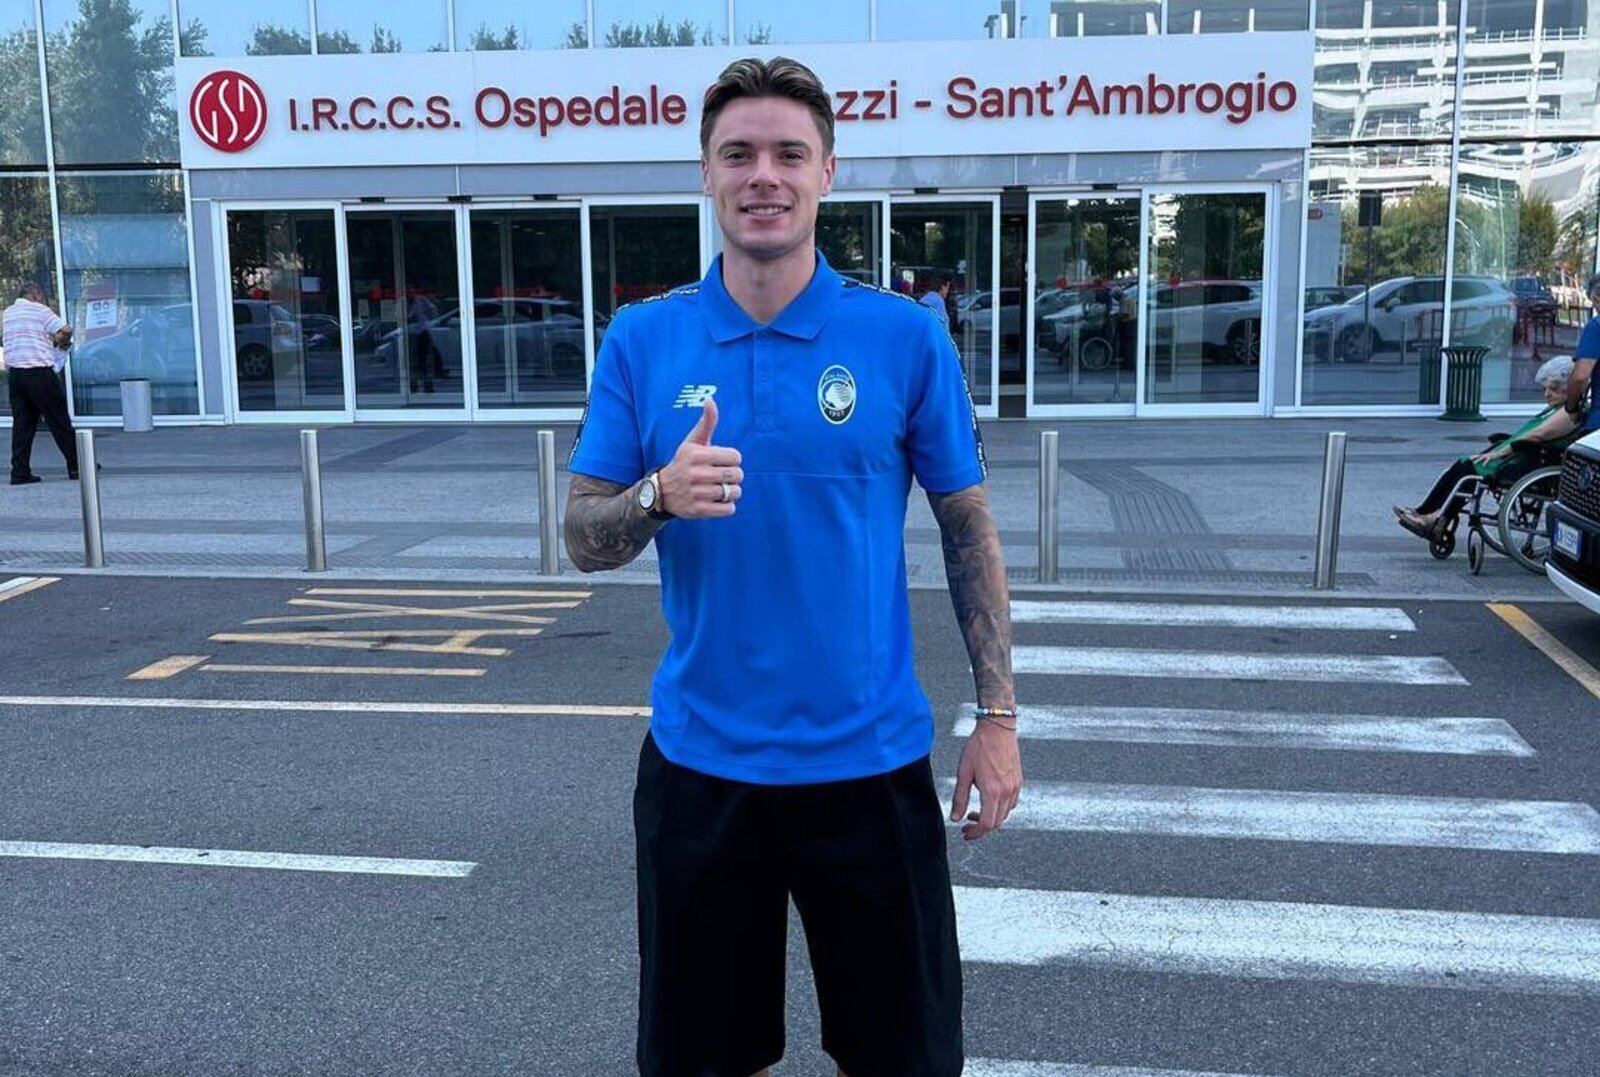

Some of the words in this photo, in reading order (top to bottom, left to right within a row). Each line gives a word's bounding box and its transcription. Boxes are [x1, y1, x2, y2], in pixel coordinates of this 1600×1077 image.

[288, 95, 461, 131] I.R.C.C.S.
[474, 84, 687, 137] Ospedale
[946, 72, 1298, 124] Sant’Ambrogio
